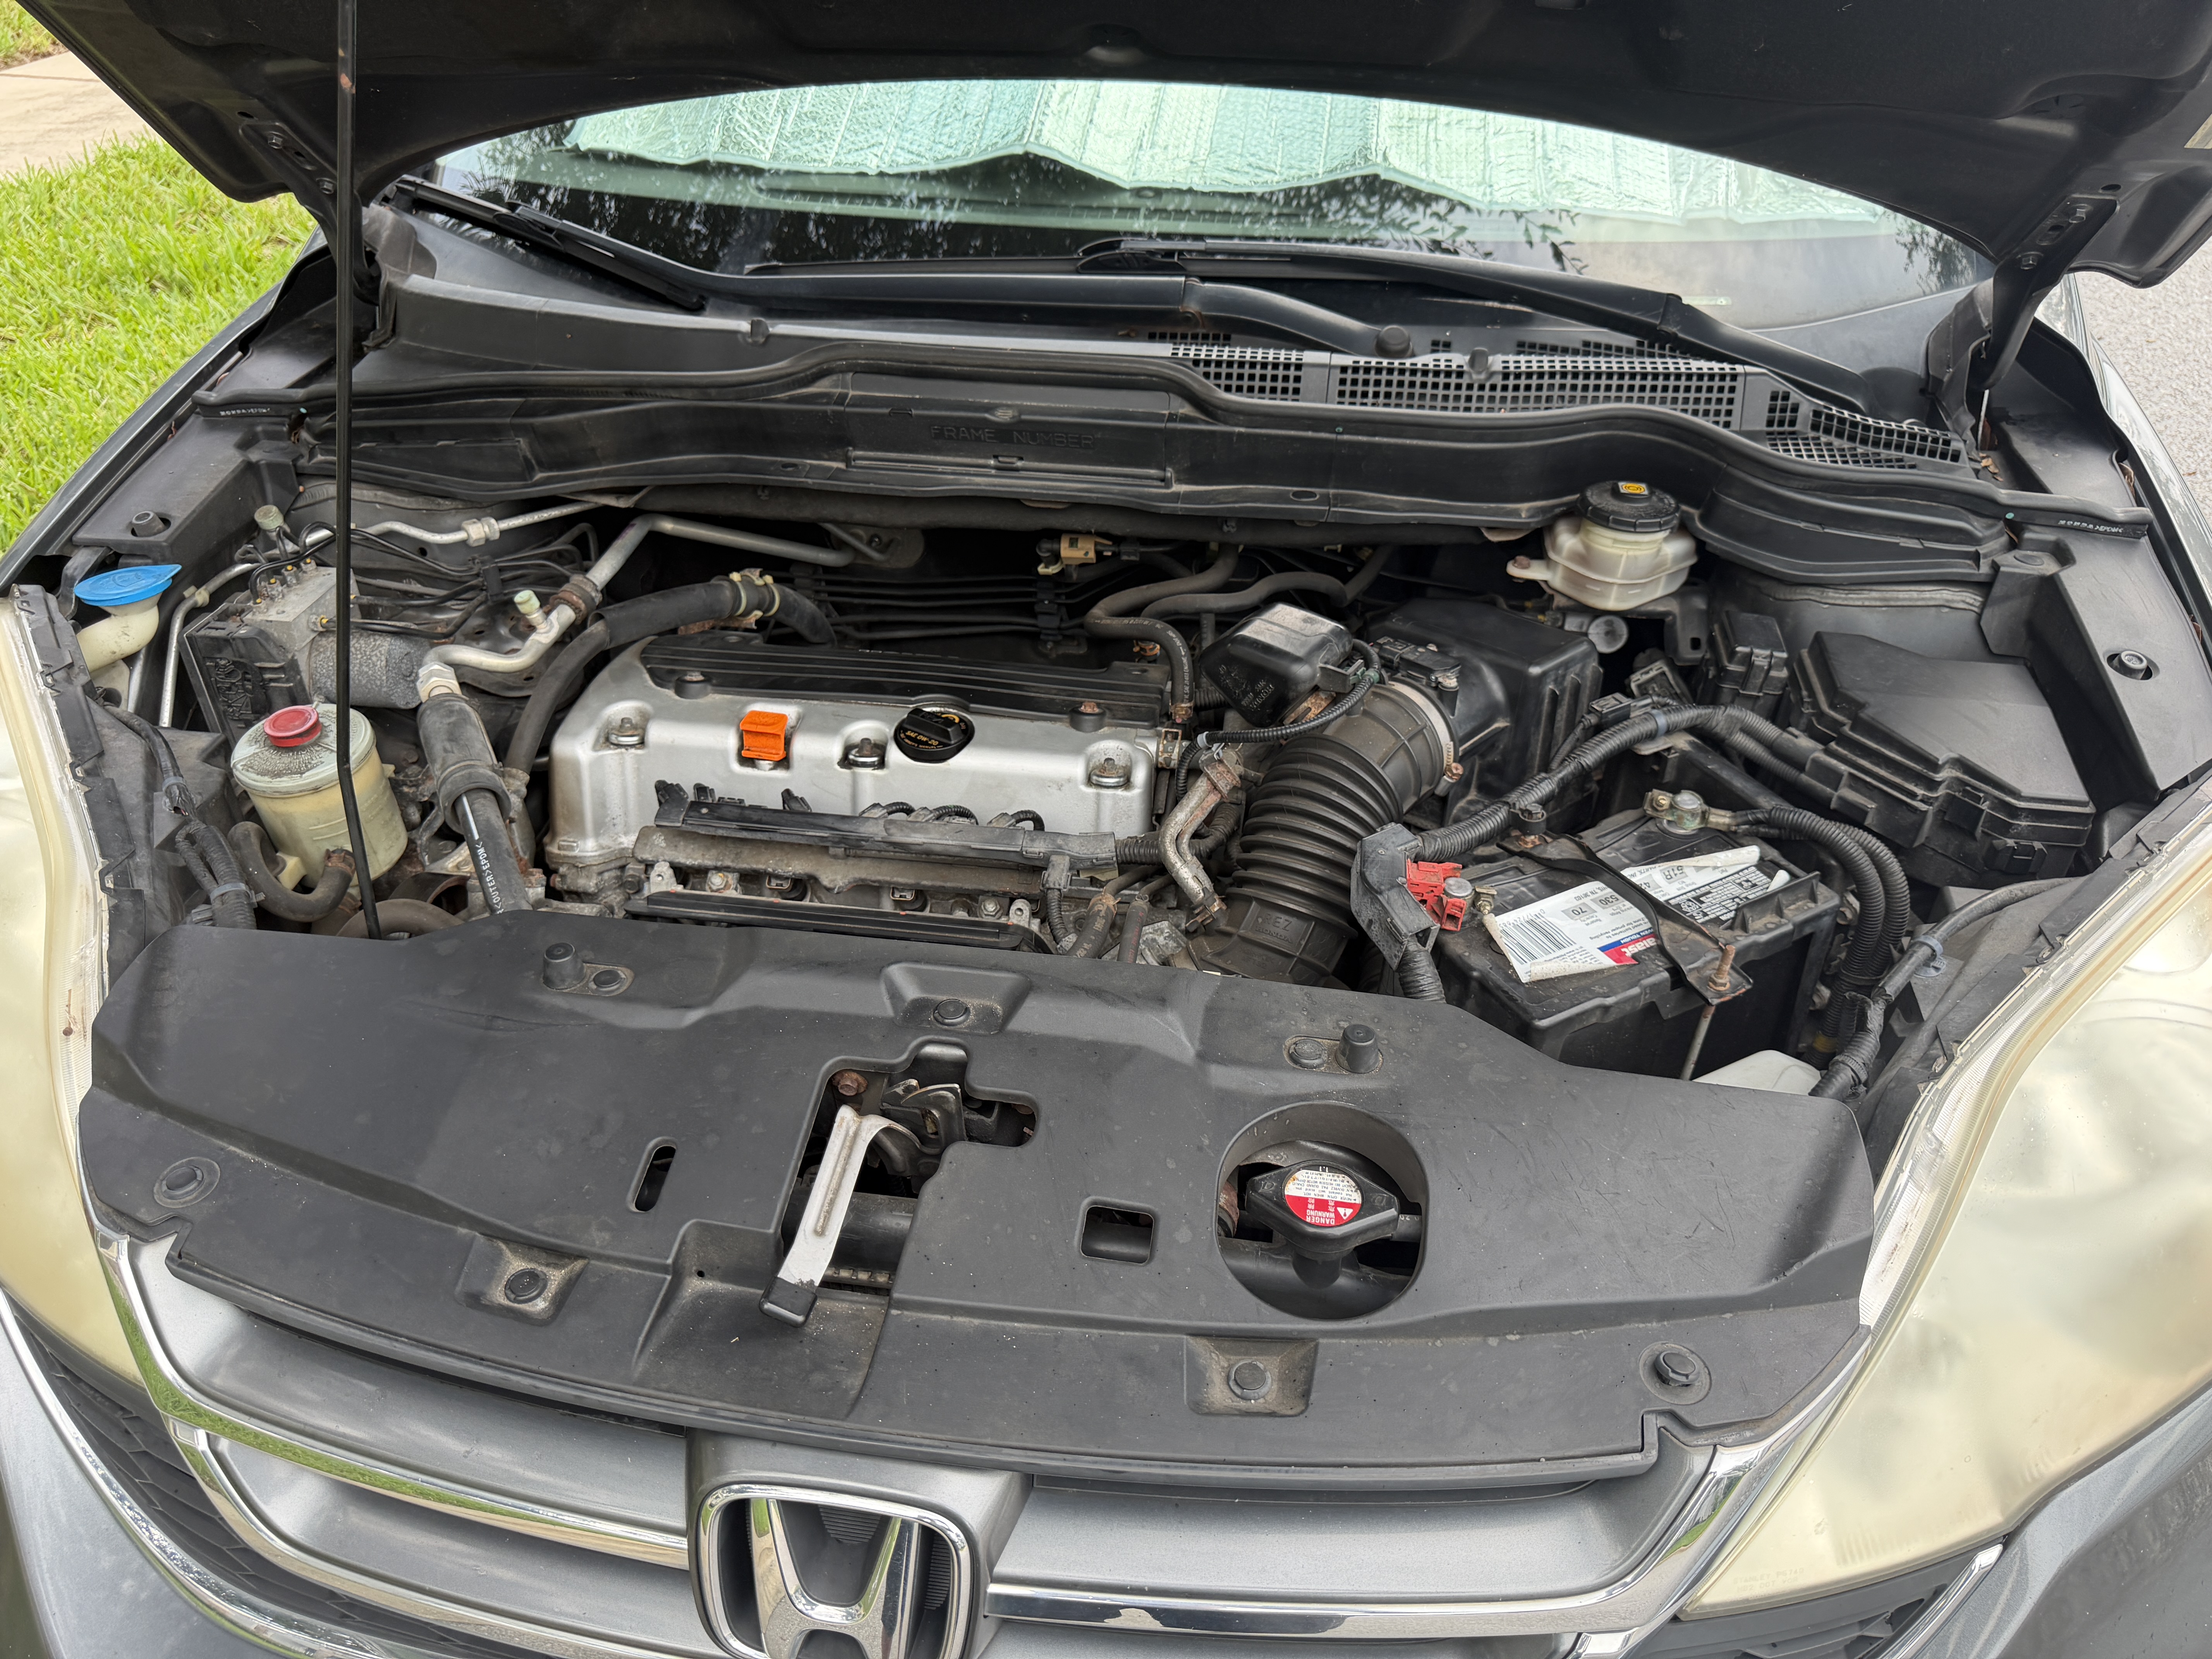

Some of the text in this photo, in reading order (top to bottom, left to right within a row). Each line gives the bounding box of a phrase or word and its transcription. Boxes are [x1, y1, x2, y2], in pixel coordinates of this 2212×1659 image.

[930, 426, 1095, 448] FRAME NUMBER
[917, 735, 939, 745] 0W-20
[1662, 865, 1684, 881] 51R
[1598, 893, 1619, 907] 530
[1571, 905, 1587, 916] 70
[1263, 914, 1292, 931] REZ
[1255, 926, 1293, 943] HONDA
[1306, 1209, 1334, 1218] WARNUNG
[1306, 1215, 1335, 1224] DANGER
[1733, 1573, 1771, 1584] STANLEY
[1759, 1580, 1776, 1588] DOT
